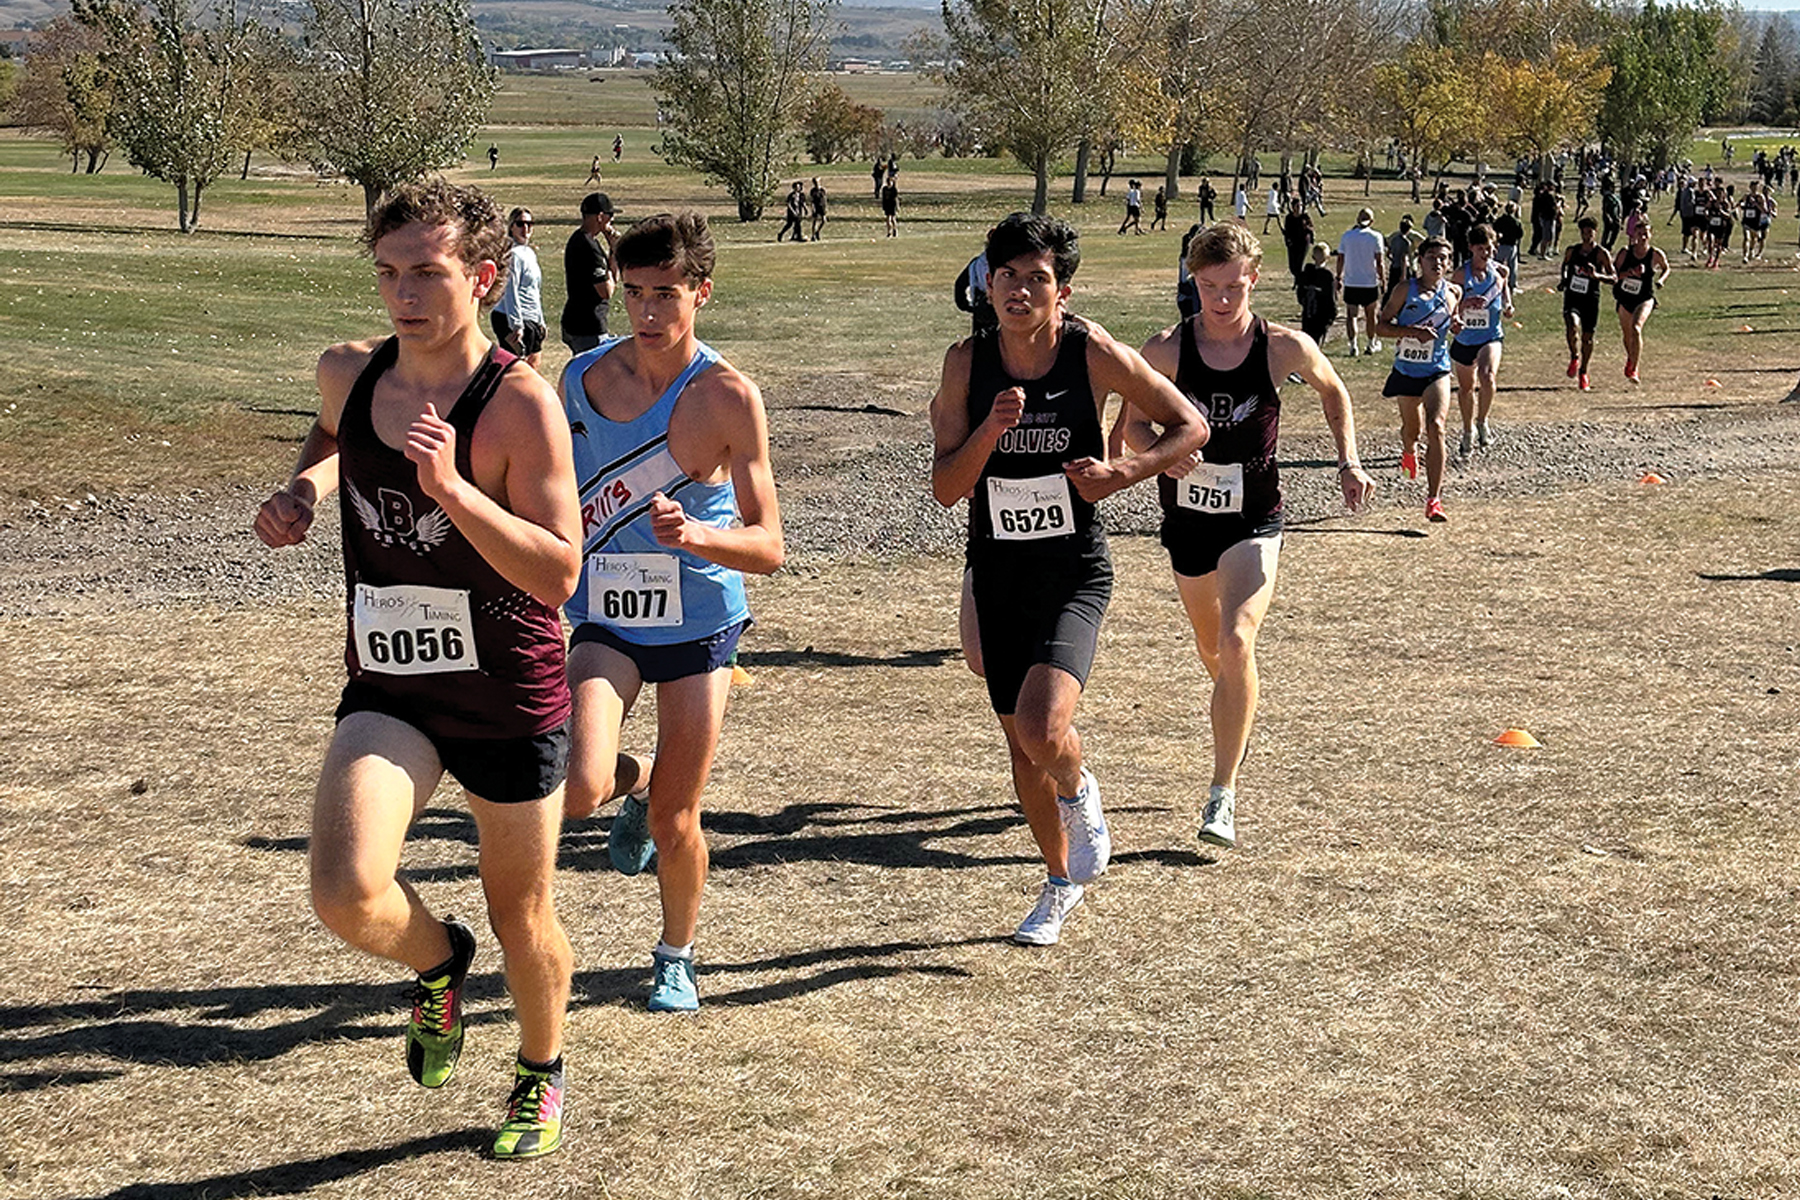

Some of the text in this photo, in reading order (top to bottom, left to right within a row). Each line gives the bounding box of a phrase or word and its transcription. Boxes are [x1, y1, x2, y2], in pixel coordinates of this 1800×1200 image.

[1210, 393, 1234, 420] B
[995, 427, 1071, 453] OLVES
[1188, 484, 1232, 509] 5751
[378, 487, 415, 536] B
[999, 505, 1065, 533] 6529
[603, 589, 668, 619] 6077
[368, 627, 464, 664] 6056
